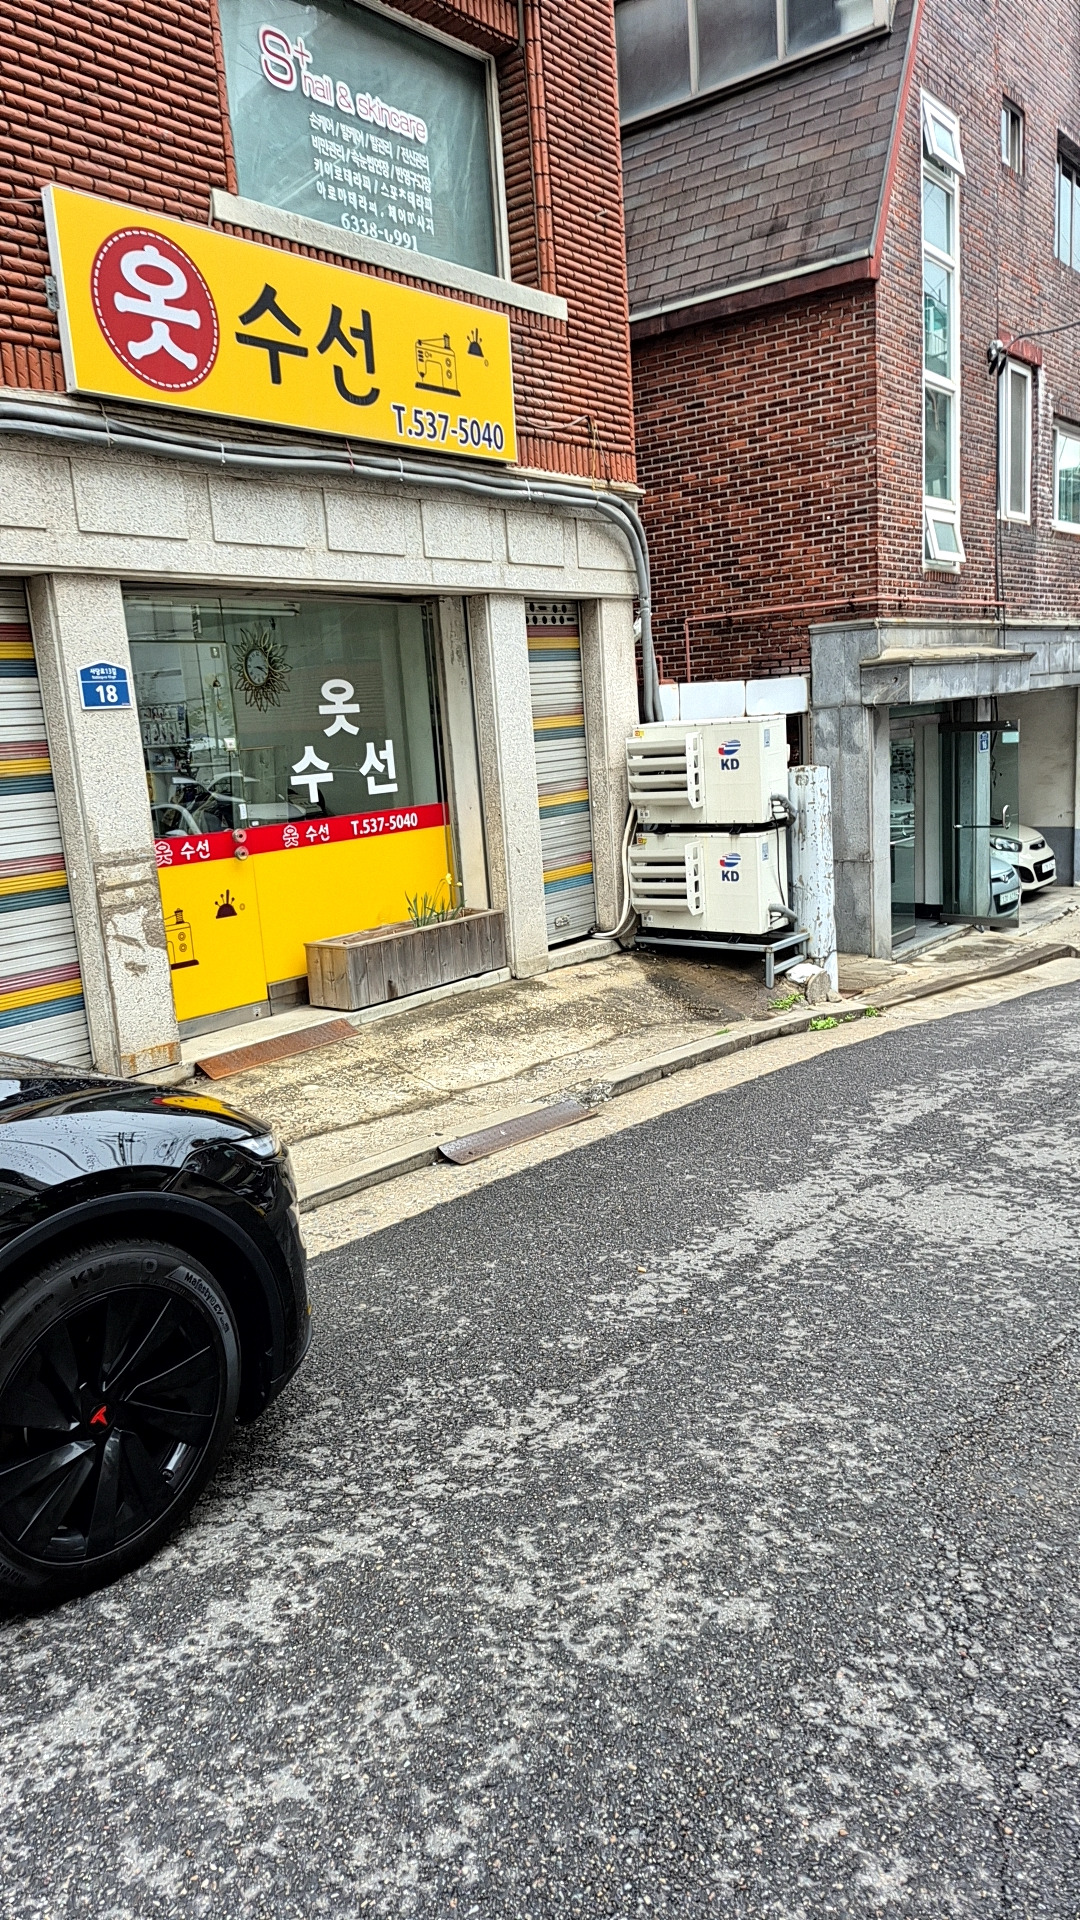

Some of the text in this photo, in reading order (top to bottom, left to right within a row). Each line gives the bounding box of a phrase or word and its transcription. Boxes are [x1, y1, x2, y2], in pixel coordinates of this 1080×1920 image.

[302, 73, 334, 105] nail
[337, 82, 354, 113] &
[356, 94, 427, 143] skincare
[113, 244, 380, 406] 옷 수선
[391, 403, 505, 452] T.537-5040
[95, 684, 119, 703] 18
[318, 678, 361, 738] 옷
[721, 758, 740, 770] KD
[283, 812, 418, 848] 옷 수선 T.537-5040
[180, 840, 211, 861] 수선
[721, 870, 740, 882] KD
